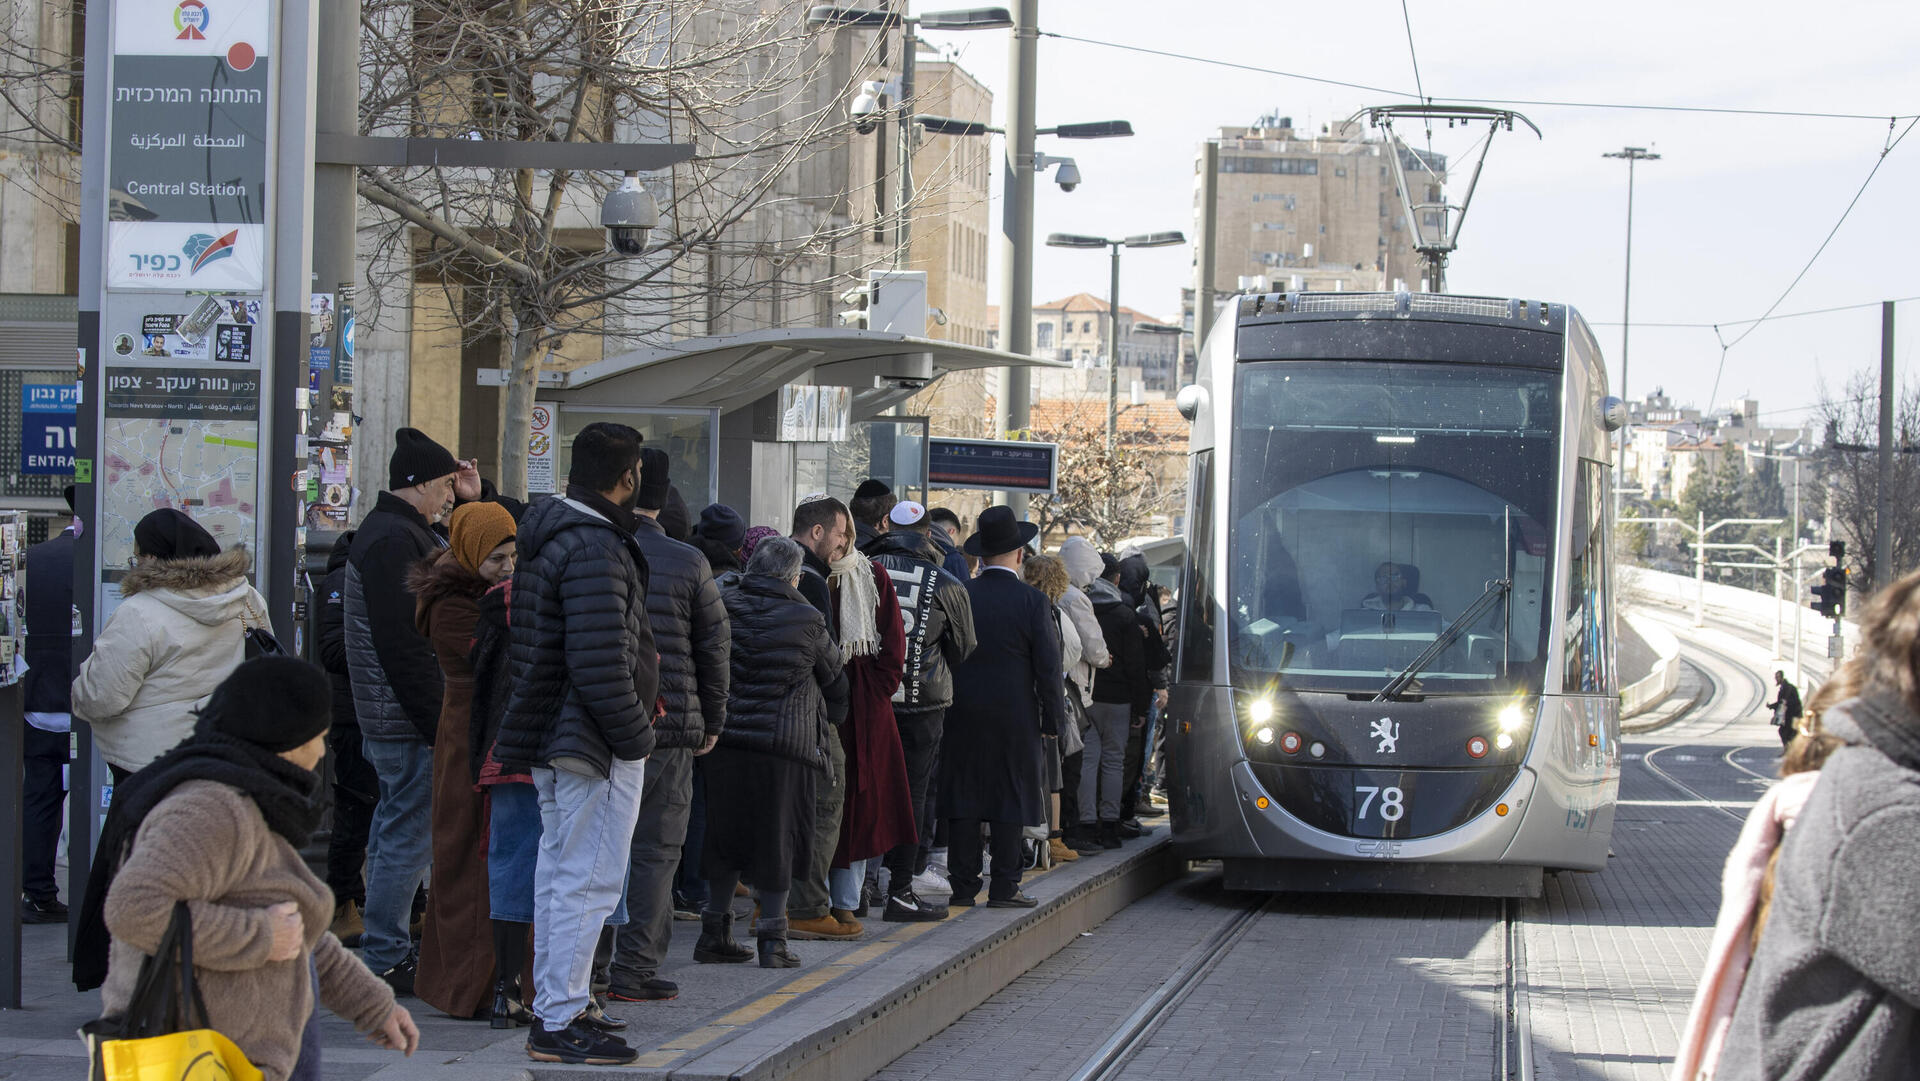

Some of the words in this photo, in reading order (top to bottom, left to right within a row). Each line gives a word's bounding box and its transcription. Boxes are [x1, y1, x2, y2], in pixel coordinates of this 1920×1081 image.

[116, 87, 192, 103] המרכזית
[200, 88, 261, 104] התחנה
[130, 132, 186, 150] المركزية
[193, 134, 245, 148] المحطة
[127, 180, 184, 195] Central
[189, 181, 246, 196] Station
[129, 254, 181, 270] כפיר
[109, 376, 142, 391] צפון
[155, 376, 196, 392] יעקב
[200, 376, 229, 390] נווה
[232, 380, 256, 393] לכיוון
[31, 388, 56, 401] נבון
[60, 388, 77, 402] חק
[28, 455, 76, 467] ENTRA
[924, 570, 937, 604] LIVING
[913, 607, 930, 676] SUCCESSFUL
[912, 680, 920, 703] FOR
[1355, 786, 1404, 821] 78
[1355, 839, 1402, 859] CAF
